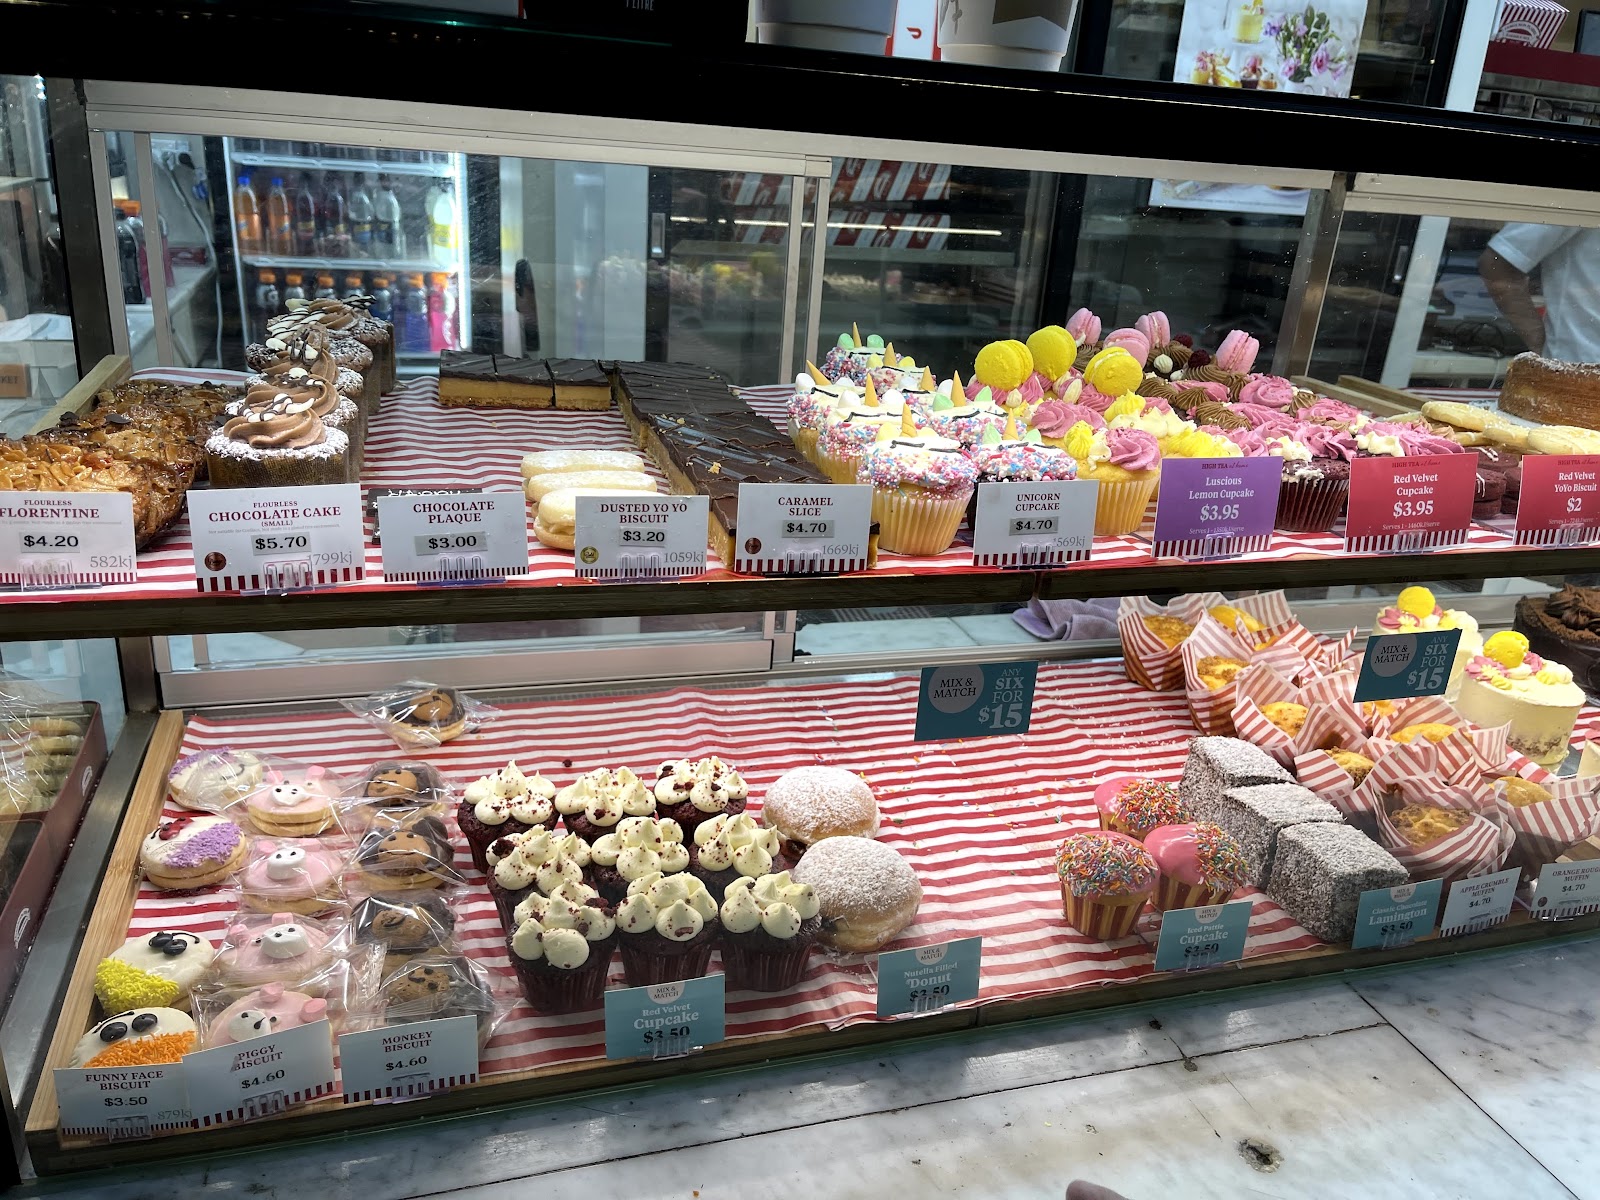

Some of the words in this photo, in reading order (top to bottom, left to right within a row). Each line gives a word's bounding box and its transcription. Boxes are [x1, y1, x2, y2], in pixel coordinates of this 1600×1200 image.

[1206, 476, 1242, 486] Luscious
[1394, 474, 1410, 484] Red
[1412, 473, 1438, 482] Velvet
[1559, 472, 1572, 480] Red
[1574, 472, 1595, 480] Velvet
[1396, 486, 1434, 497] Cupcake
[1555, 484, 1572, 492] YoYo
[1573, 483, 1597, 492] Biscuit
[1017, 493, 1061, 502] UNICORN
[1189, 490, 1218, 500] Lemon
[1220, 488, 1254, 499] Cupcake
[413, 501, 494, 512] CHOCOLATE
[778, 497, 833, 506] CARAMEL
[1015, 503, 1060, 511] CUPCAKE
[1567, 496, 1582, 514] $2
[0, 508, 100, 518] FLORENTINE
[208, 508, 300, 522] CHOCOLATE
[303, 507, 341, 518] CAKE
[600, 504, 650, 513] DUSTED
[653, 504, 668, 512] YO
[672, 504, 687, 512] YO
[789, 508, 822, 516] SLICE
[1200, 504, 1240, 522] $3.95
[1393, 500, 1434, 519] $3.95
[261, 520, 293, 528] (SMALL)
[428, 513, 482, 524] PLAQUE
[620, 515, 669, 523] BISCUIT
[787, 523, 827, 533] $4.70
[1015, 520, 1053, 530] $4.70
[24, 535, 79, 547] $4.20
[428, 536, 477, 549] $3.00
[622, 531, 665, 542] $3.20
[255, 536, 307, 550] $5.70
[822, 544, 859, 557] 1669kj
[90, 556, 132, 570] 582kj
[664, 552, 704, 564] 1059kj
[1431, 636, 1448, 644] ANY
[1381, 645, 1400, 654] MIX
[1425, 644, 1450, 656] SIX
[1375, 653, 1410, 664] MATCH
[1421, 656, 1446, 668] FOR
[1001, 668, 1021, 677] ANY
[940, 678, 962, 688] MIX
[965, 677, 973, 686] &
[995, 677, 1024, 689] SIX
[1407, 667, 1444, 691] $15
[934, 688, 976, 698] MATCH
[992, 691, 1023, 703] FOR
[978, 703, 1023, 729] $15
[1460, 885, 1480, 893] APPLE
[1480, 878, 1509, 889] CRUMBLE
[1562, 884, 1585, 892] $4.70
[1472, 887, 1495, 897] MUFFIN
[1372, 905, 1395, 914] Classic
[1396, 900, 1428, 910] Chocolate
[1469, 897, 1491, 908] $4.70
[1369, 908, 1427, 926] Lamington
[1187, 926, 1203, 934] Iced
[1381, 921, 1413, 936] $350
[1180, 930, 1228, 945] Cupcake
[920, 952, 942, 960] MATCH
[904, 967, 934, 978] Nutella
[935, 962, 958, 972] Filled
[906, 972, 951, 988] Donut
[654, 991, 679, 1000] MATCH
[642, 1007, 660, 1016] Red
[662, 1004, 690, 1013] Velvet
[634, 1011, 699, 1030] Cupcake
[382, 1031, 433, 1045] MONKEY
[644, 1026, 690, 1044] $350
[238, 1045, 276, 1060] PIGGY
[385, 1040, 432, 1053] BISCUIT
[234, 1052, 283, 1071] BISCUIT
[386, 1056, 427, 1071] $4.60
[85, 1073, 129, 1082] FUNNY
[132, 1071, 163, 1080] FACE
[241, 1069, 285, 1089] $4.60
[100, 1081, 150, 1090] BISCUIT
[104, 1096, 148, 1107] $3.50
[157, 1108, 192, 1120] 879kj
